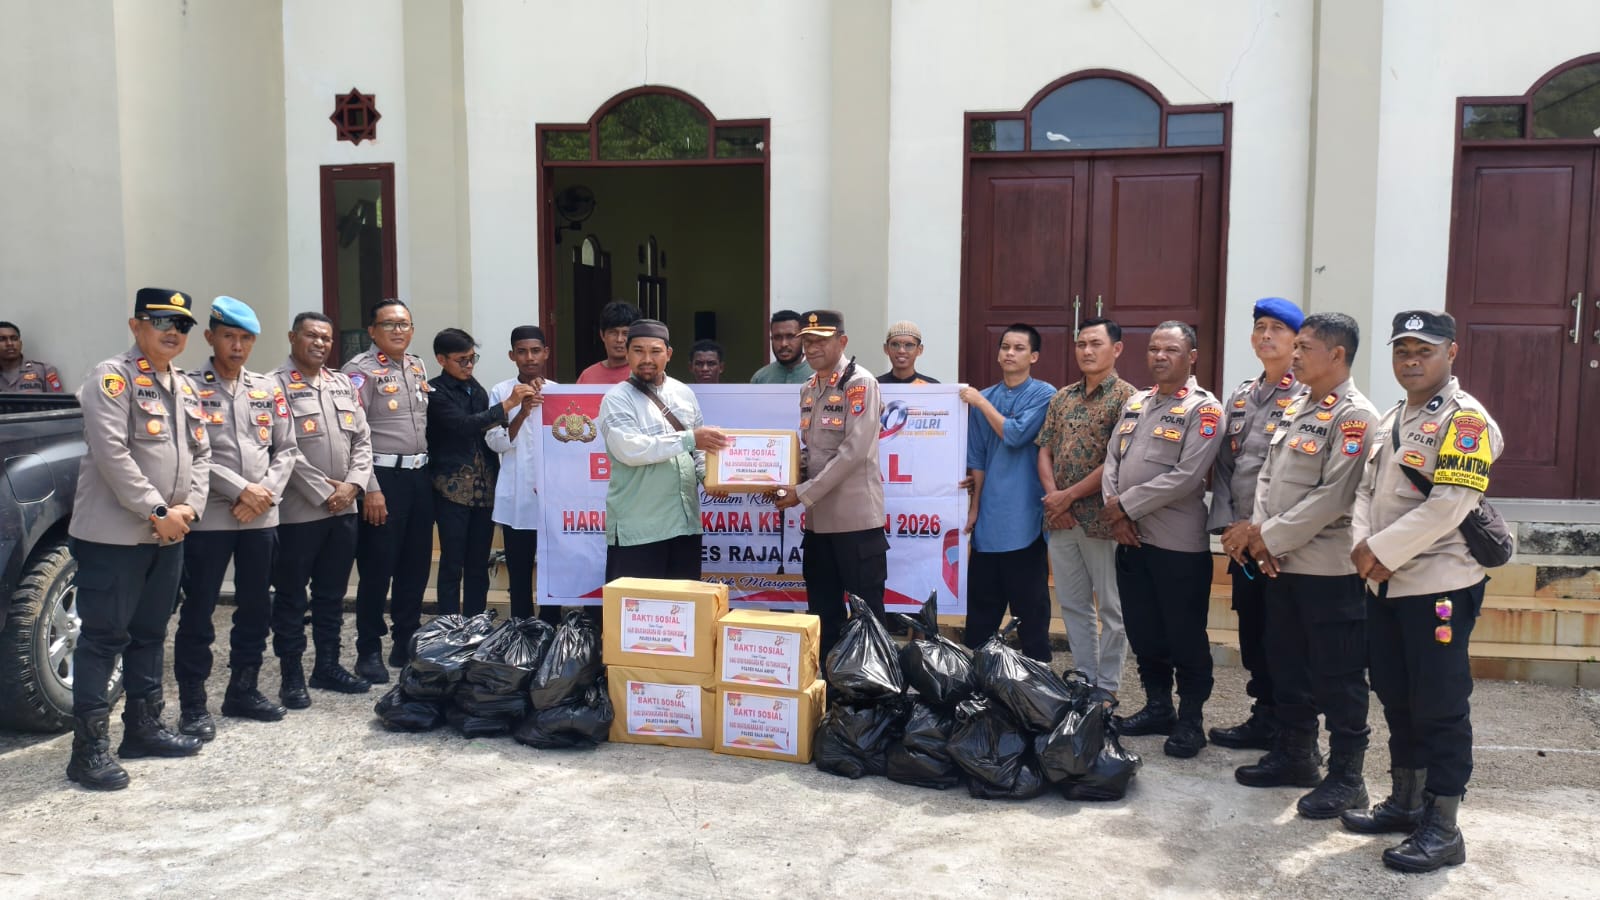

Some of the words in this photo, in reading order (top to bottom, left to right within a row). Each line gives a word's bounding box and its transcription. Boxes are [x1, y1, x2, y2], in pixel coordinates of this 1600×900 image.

[1160, 415, 1185, 426] POLRI
[1299, 423, 1328, 437] POLRI
[729, 449, 750, 457] BAKTI
[752, 449, 776, 457] SOSIAL
[562, 510, 607, 533] HARI
[897, 513, 941, 536] 2026
[728, 545, 781, 562] RAJA
[631, 613, 653, 623] BAKTI
[655, 615, 681, 625] SOSIAL
[734, 643, 756, 653] BAKTI
[758, 645, 785, 656] SOSIAL
[637, 696, 660, 705] BAKTI
[661, 698, 686, 708] SOSIAL
[733, 708, 756, 718] BAKTI
[757, 710, 783, 721] SOSIAL
